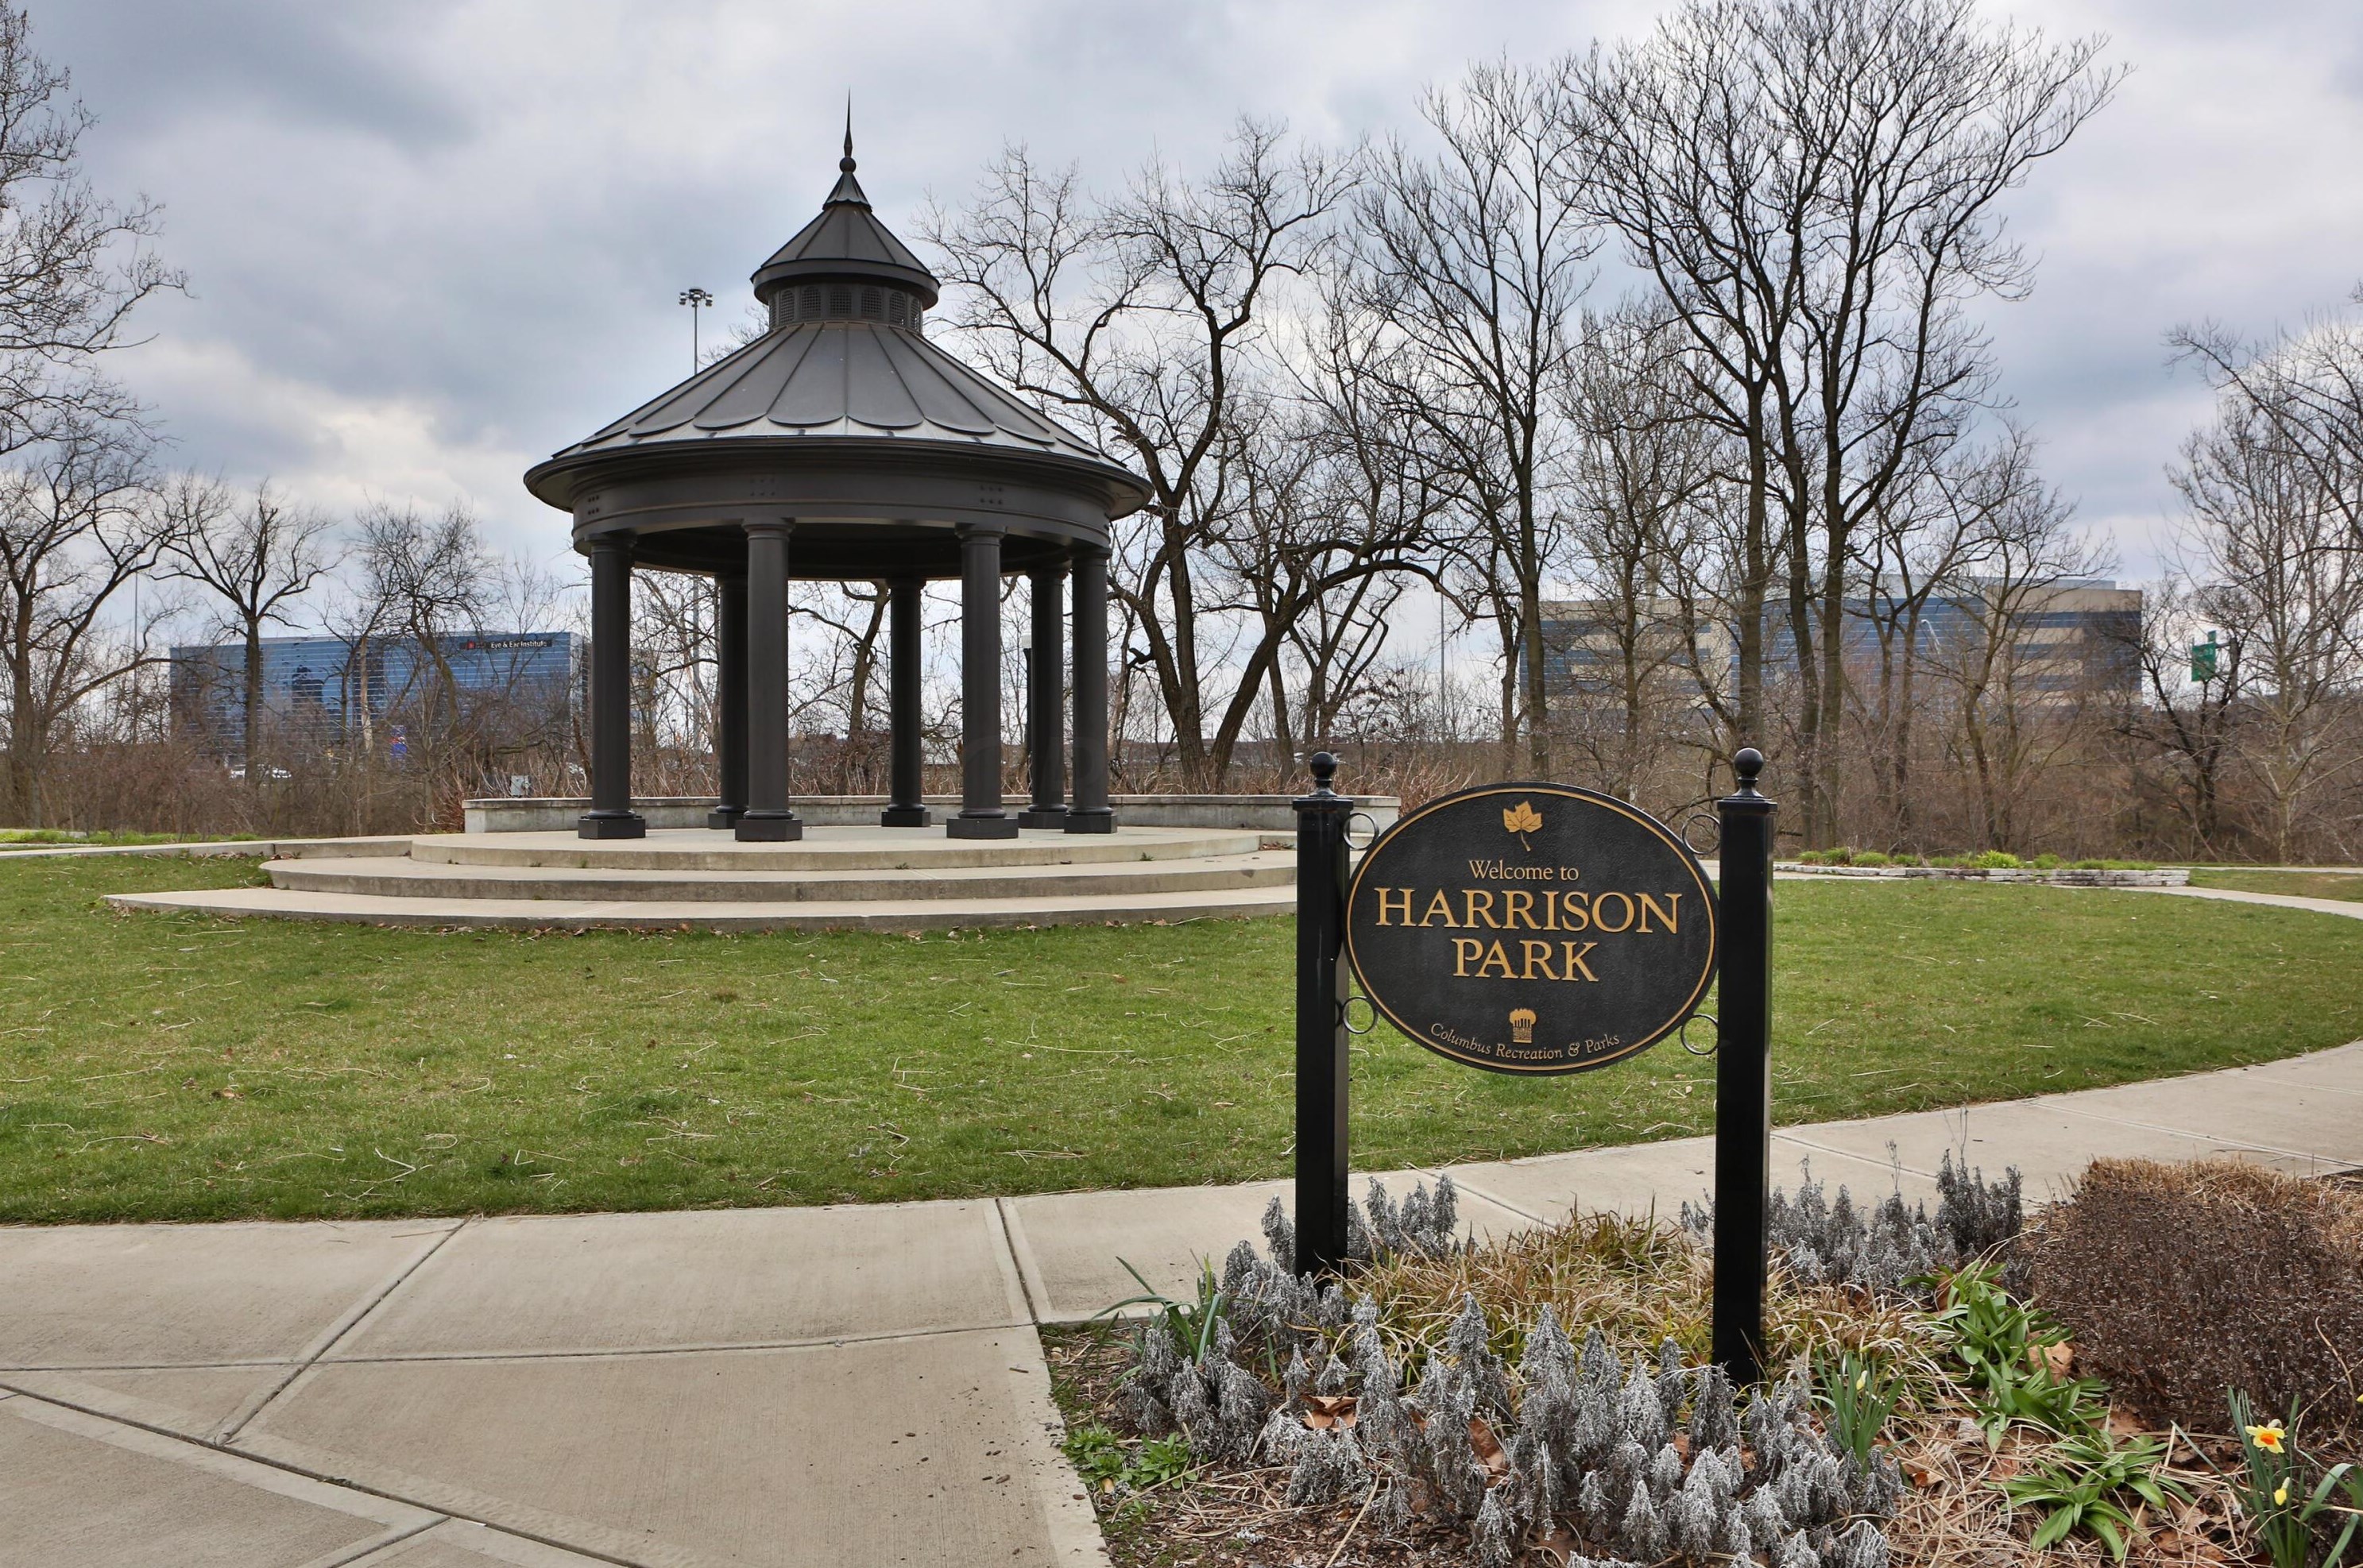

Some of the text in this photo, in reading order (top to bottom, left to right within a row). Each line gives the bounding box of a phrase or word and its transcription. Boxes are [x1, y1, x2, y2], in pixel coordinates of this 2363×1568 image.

[491, 641, 501, 650] Eye
[520, 639, 547, 648] Institute
[1468, 859, 1579, 881] Welcome to
[1374, 887, 1682, 934] HARRISON
[1451, 938, 1599, 982] PARK
[1430, 1023, 1620, 1060] Columbus Recreation & Parks
